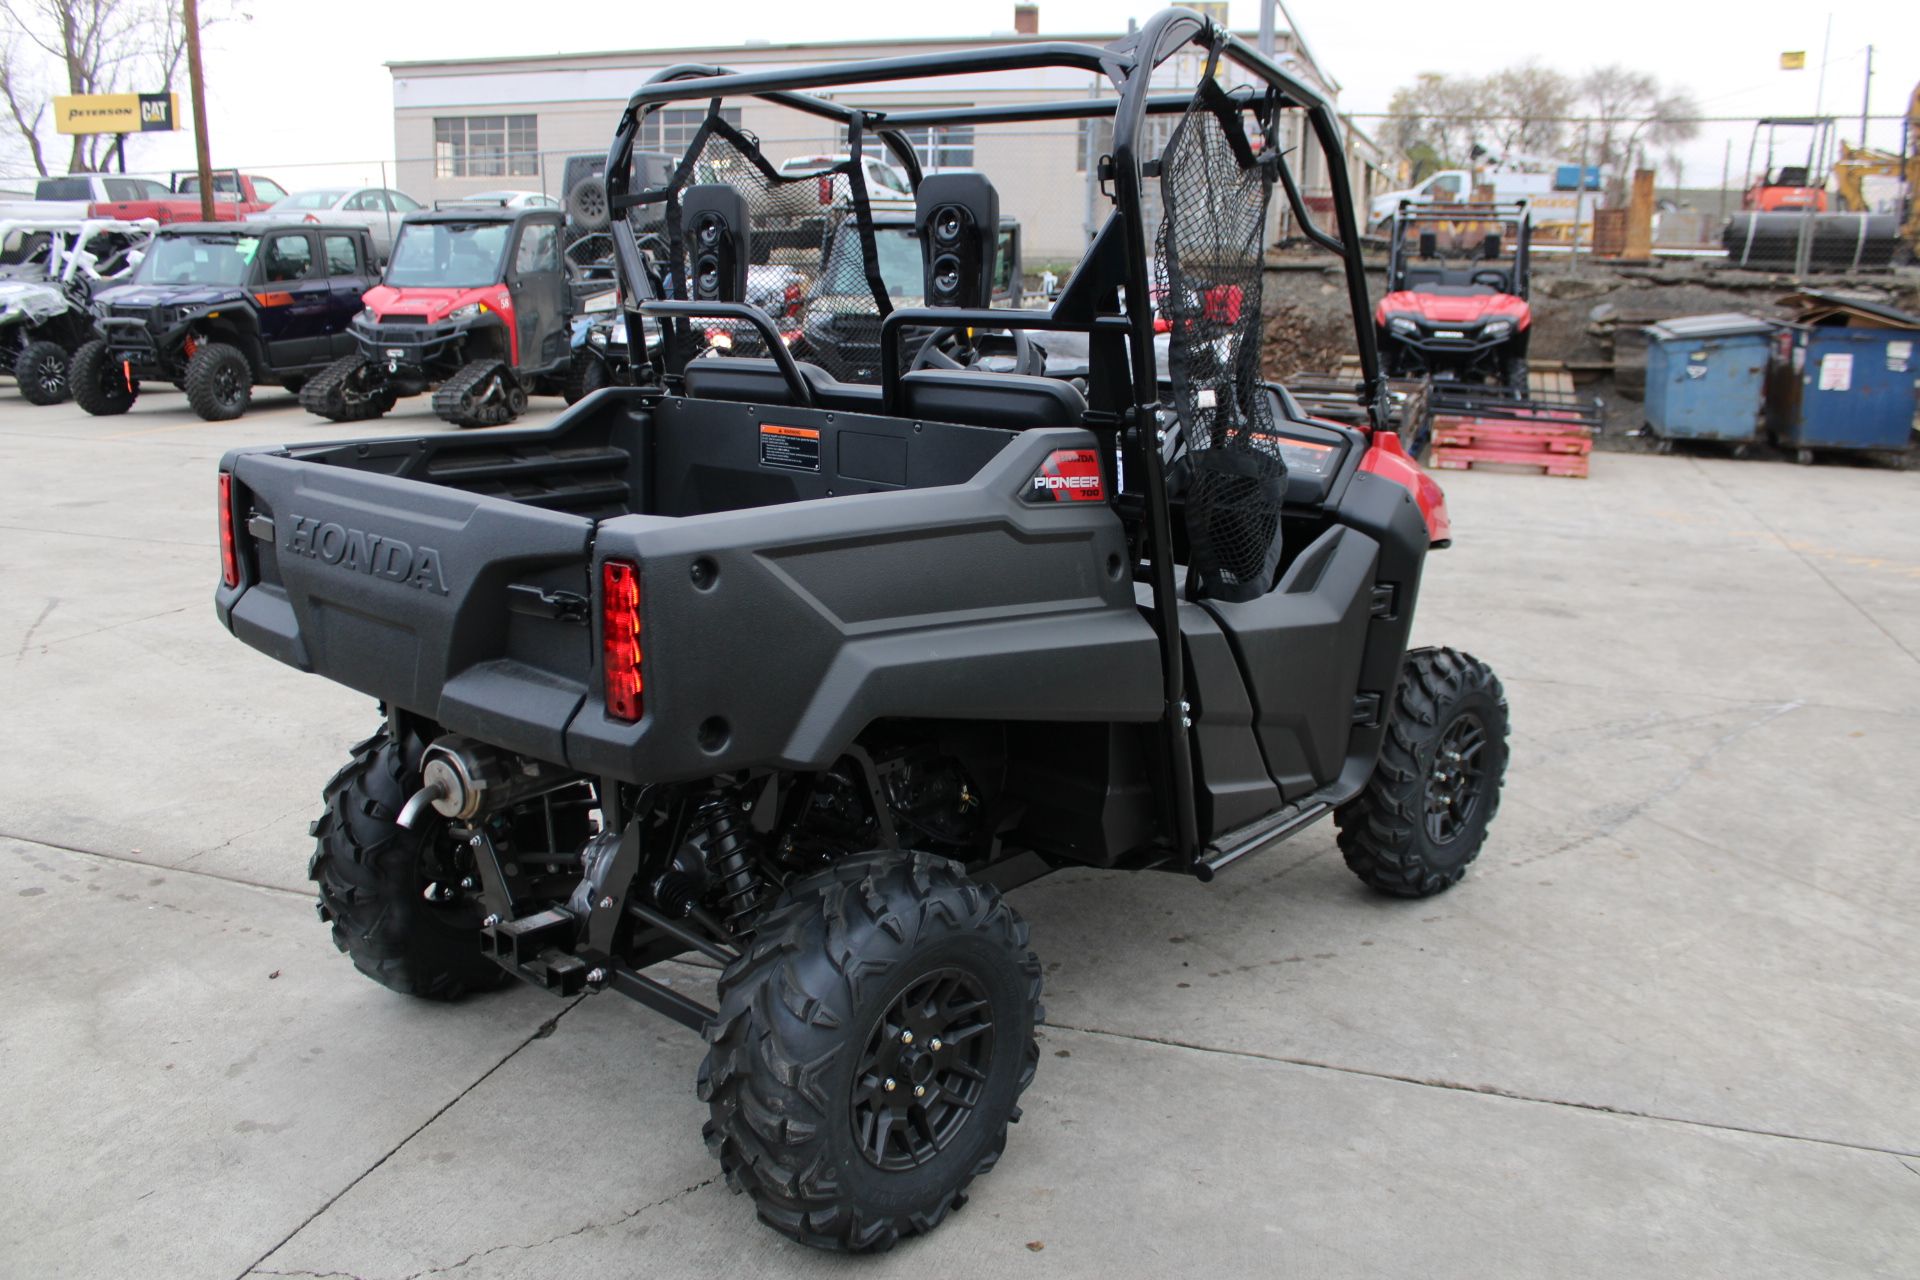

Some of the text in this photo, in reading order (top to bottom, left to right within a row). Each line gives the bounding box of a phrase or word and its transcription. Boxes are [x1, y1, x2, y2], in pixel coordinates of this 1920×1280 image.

[142, 101, 166, 122] CAT
[1034, 475, 1099, 490] PIONEER
[1080, 489, 1099, 498] 700
[285, 514, 449, 597] HONDA
